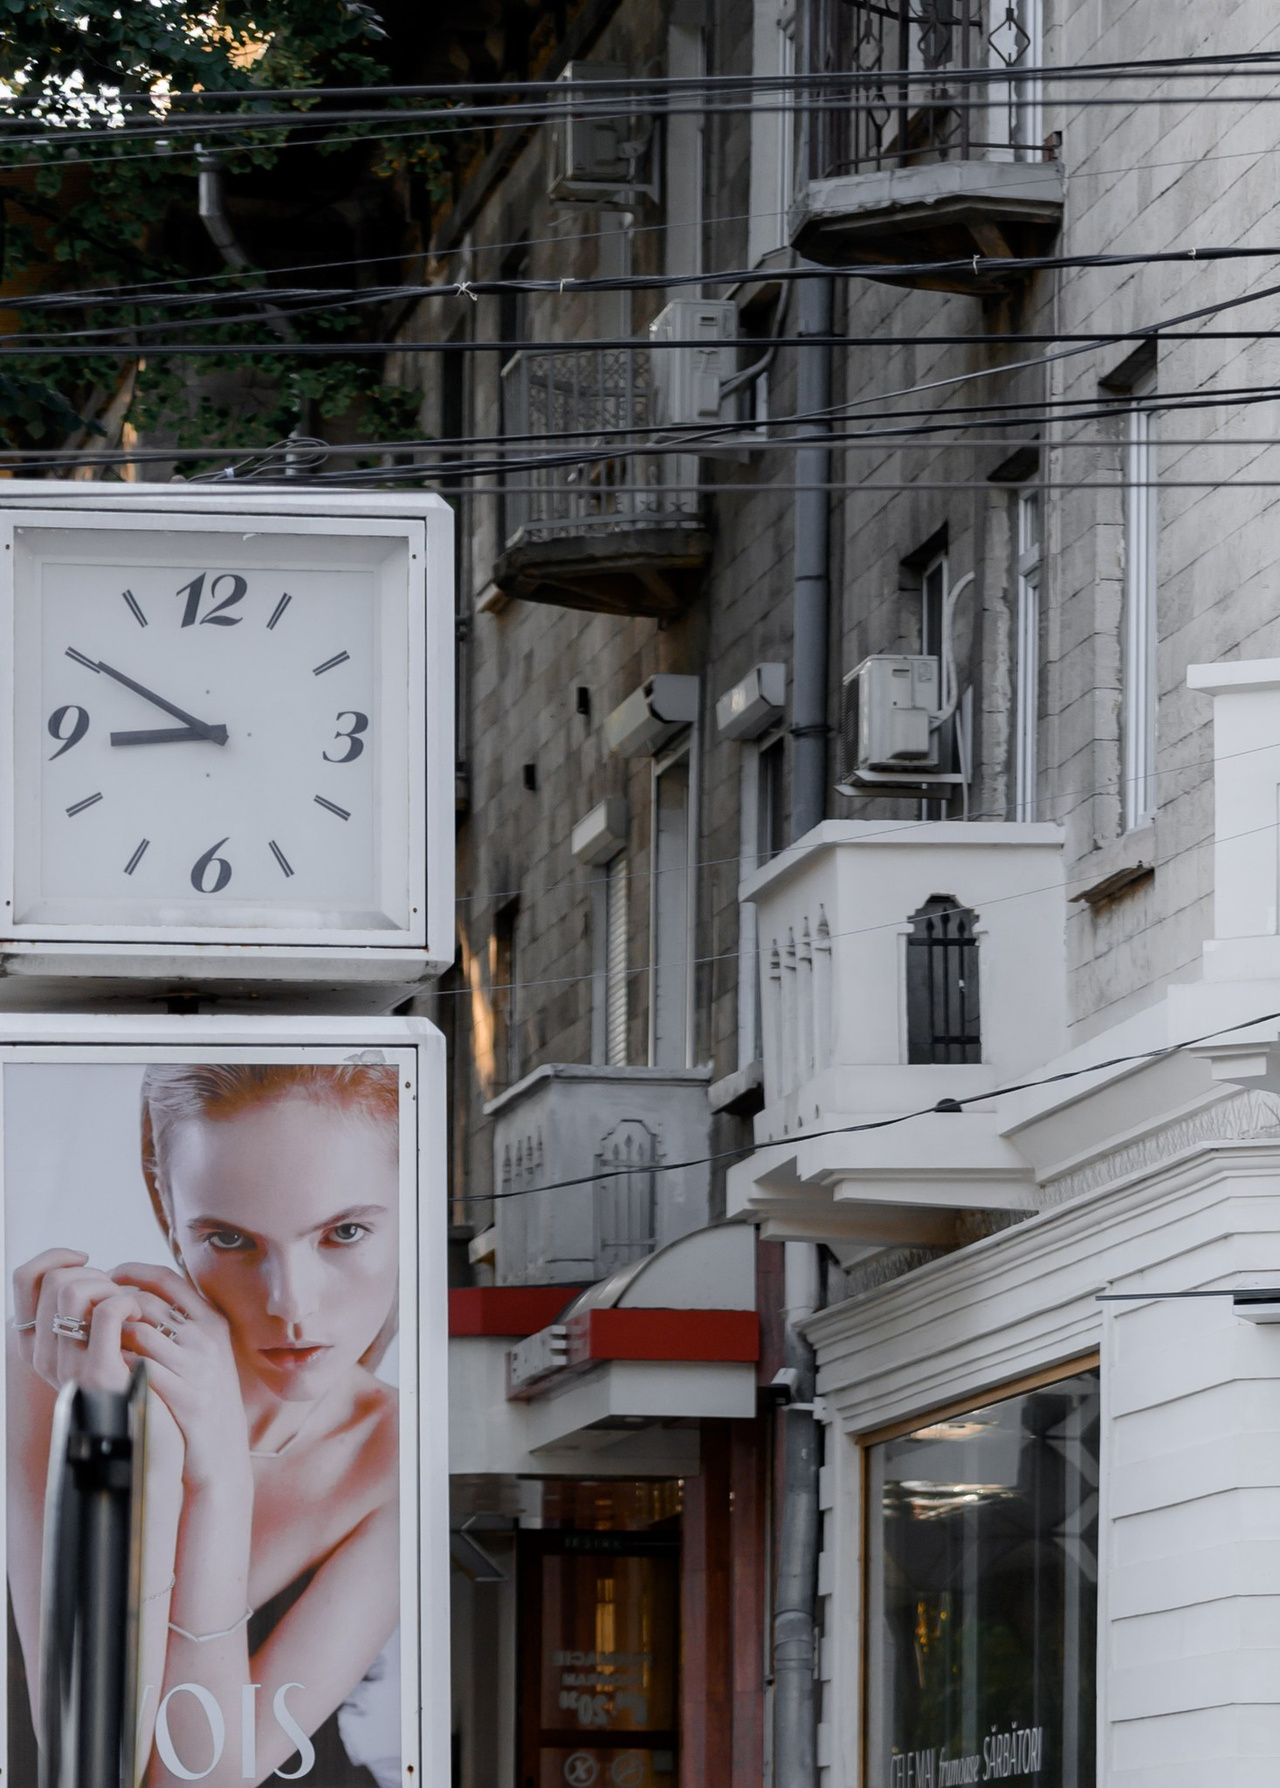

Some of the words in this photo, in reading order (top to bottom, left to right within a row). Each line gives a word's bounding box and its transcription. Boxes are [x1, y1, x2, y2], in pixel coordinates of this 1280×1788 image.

[176, 571, 248, 628] 12
[47, 705, 90, 761] 9
[322, 711, 370, 763] 3
[190, 837, 232, 894] 6
[982, 1721, 1043, 1781] SĂRBĂTORI
